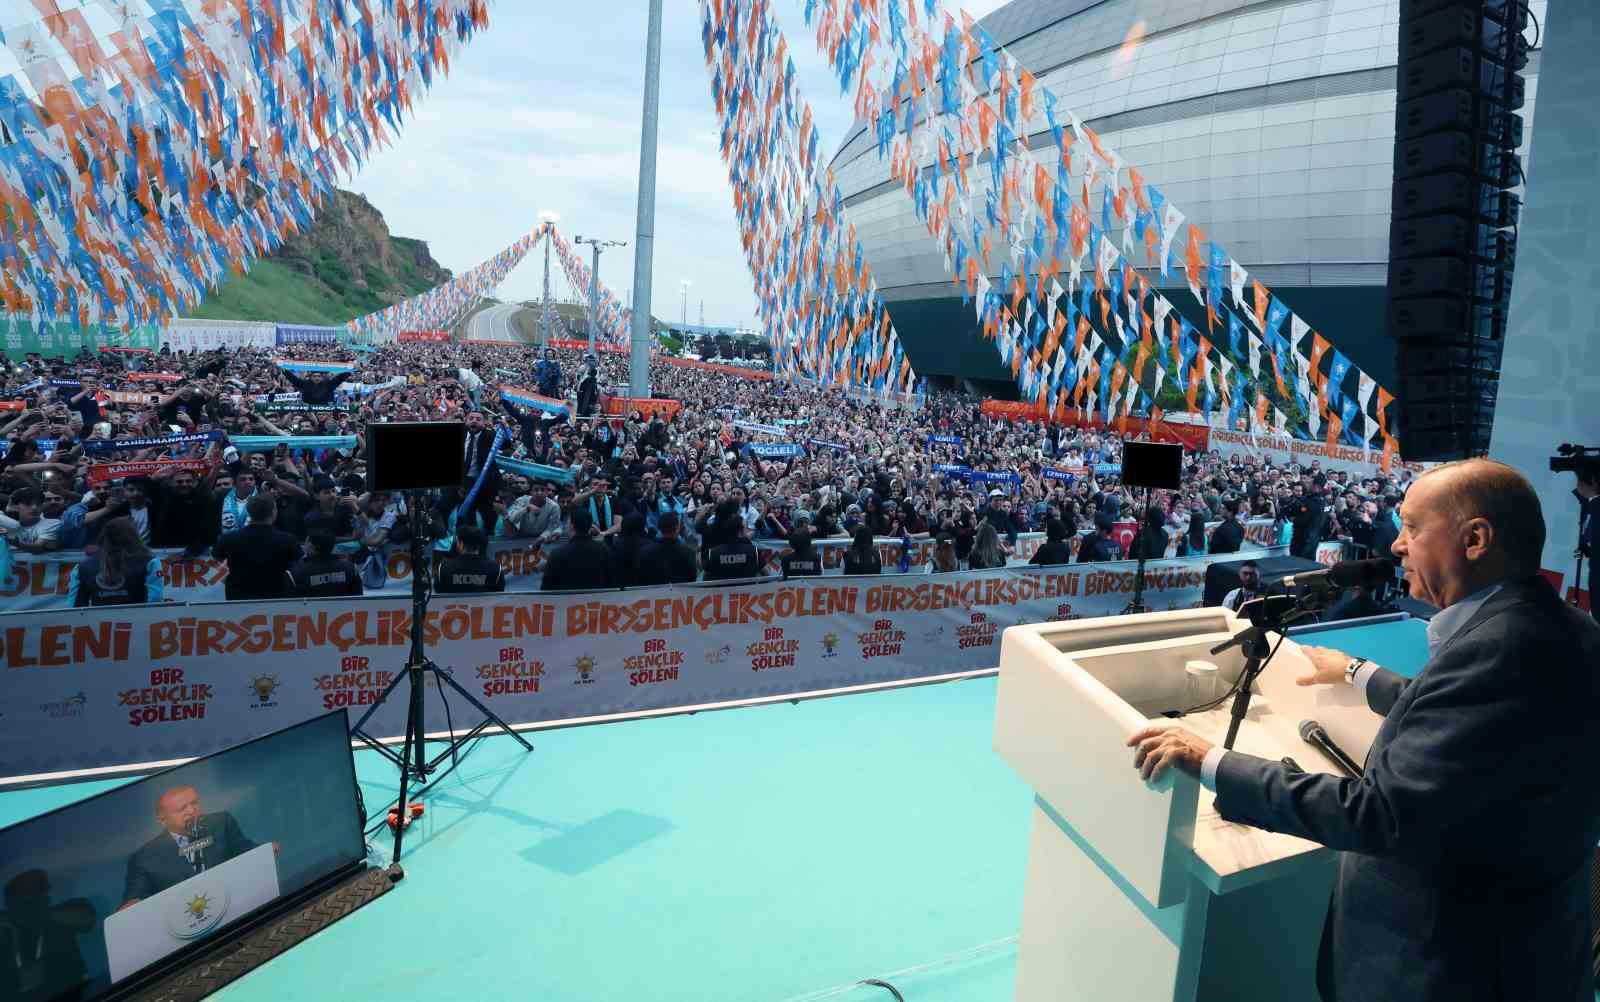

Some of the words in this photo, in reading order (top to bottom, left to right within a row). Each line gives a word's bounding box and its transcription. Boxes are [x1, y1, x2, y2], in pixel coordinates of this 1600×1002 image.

[0, 621, 132, 668] LENİ
[150, 617, 228, 660] BİR
[239, 610, 413, 654] GENÇLİK
[567, 602, 622, 637] BİR
[627, 590, 759, 634] GENÇLİK
[756, 586, 859, 625] ŞÖLENİ
[865, 584, 906, 613] BİR
[912, 578, 1005, 615] GENÇLİK
[1003, 570, 1080, 605] ŞÖLENİ
[1084, 568, 1116, 597] BİR
[1119, 565, 1191, 593] GNÇLİK
[874, 618, 894, 631] BİR
[970, 612, 987, 624] BİR
[764, 627, 784, 642] BİR
[861, 630, 906, 646] GENÇLİK
[958, 635, 993, 650] ŞÖLENİ
[499, 647, 525, 663] BİR
[644, 638, 667, 654] BİR
[750, 639, 800, 657] GENÇLİK
[862, 643, 902, 660] ŞÖLENİ
[341, 655, 369, 672] BİR
[628, 650, 685, 670] GENÇLİK
[751, 654, 795, 672] ŞÖLENİ
[150, 667, 185, 686] BİR
[479, 659, 546, 680] GENÇLİK
[629, 667, 679, 687] ŞÖLENİ
[126, 684, 213, 708] GENÇLİK
[483, 678, 541, 698] ŞÖLENİ
[322, 690, 387, 710] ŞÖLEN
[129, 703, 206, 728] ŞÖLENİ
